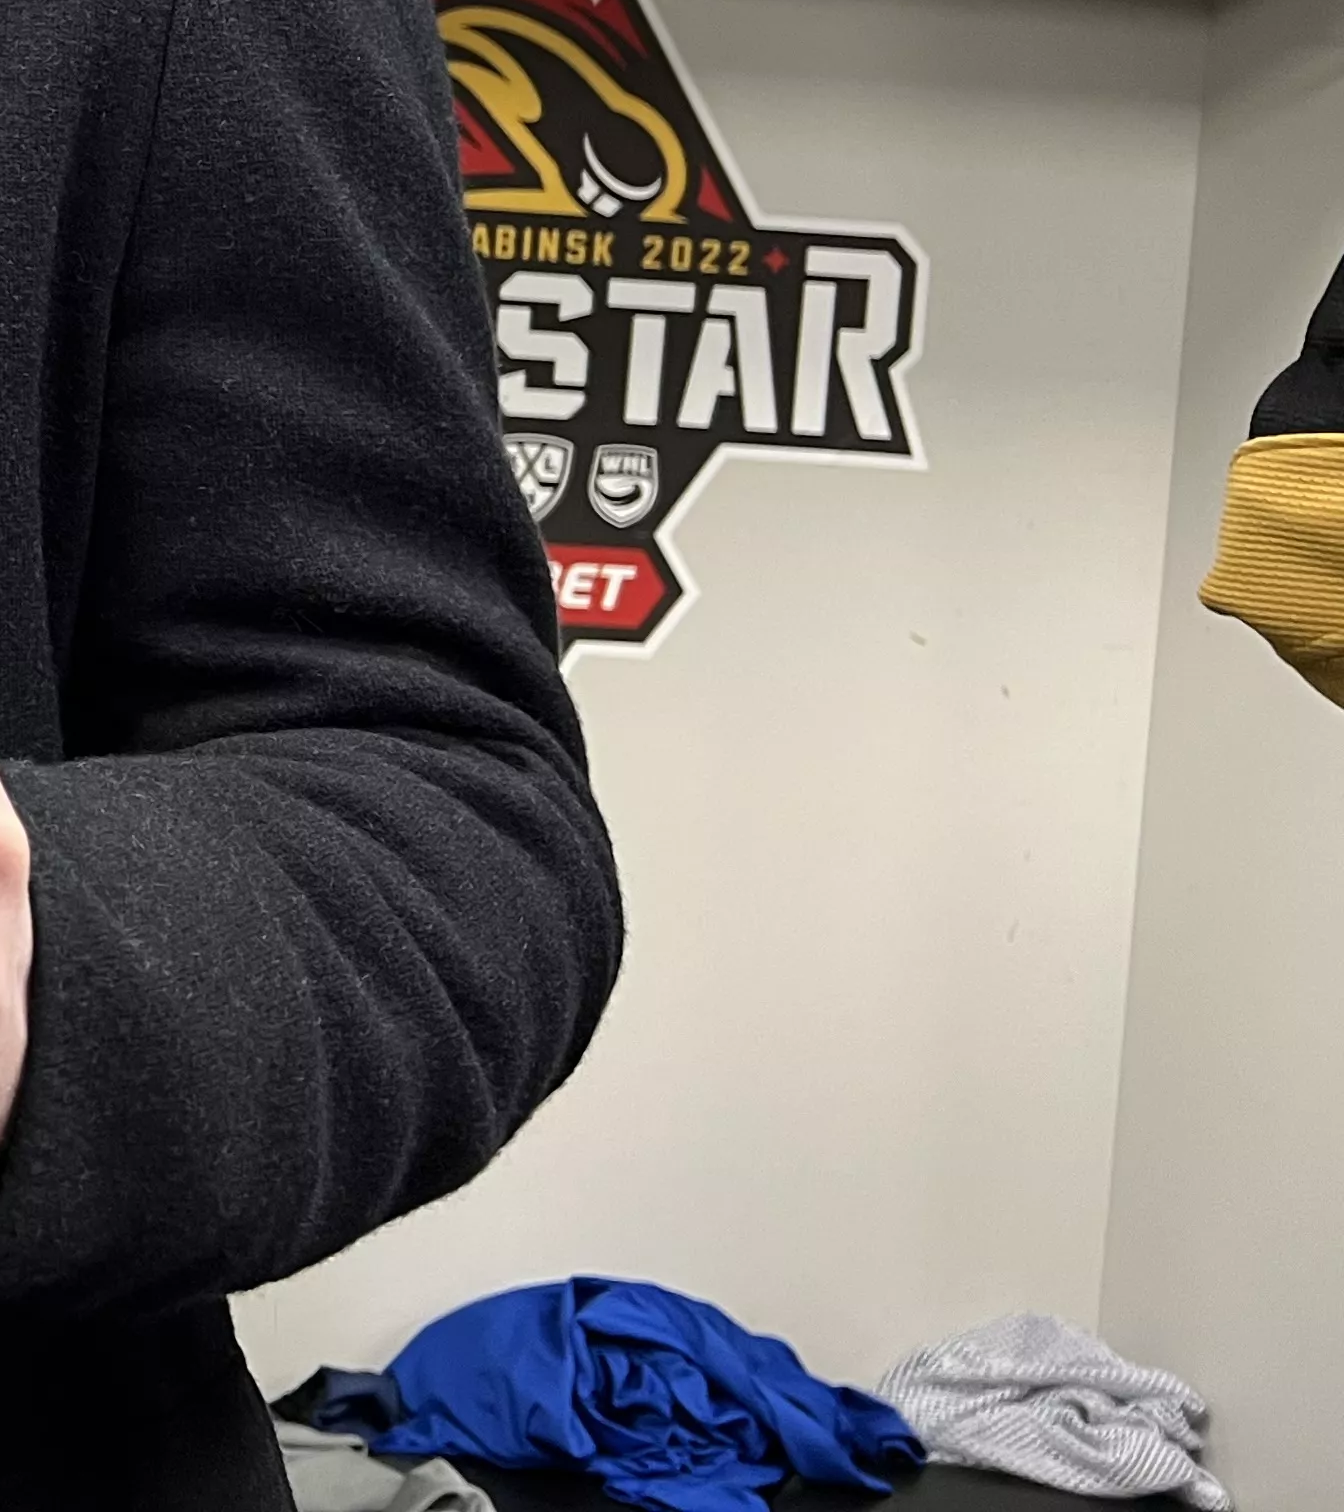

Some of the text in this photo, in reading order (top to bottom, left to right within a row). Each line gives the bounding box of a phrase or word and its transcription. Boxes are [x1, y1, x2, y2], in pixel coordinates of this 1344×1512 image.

[642, 235, 752, 275] 2022
[497, 246, 902, 441] STAR
[601, 452, 649, 476] WHL
